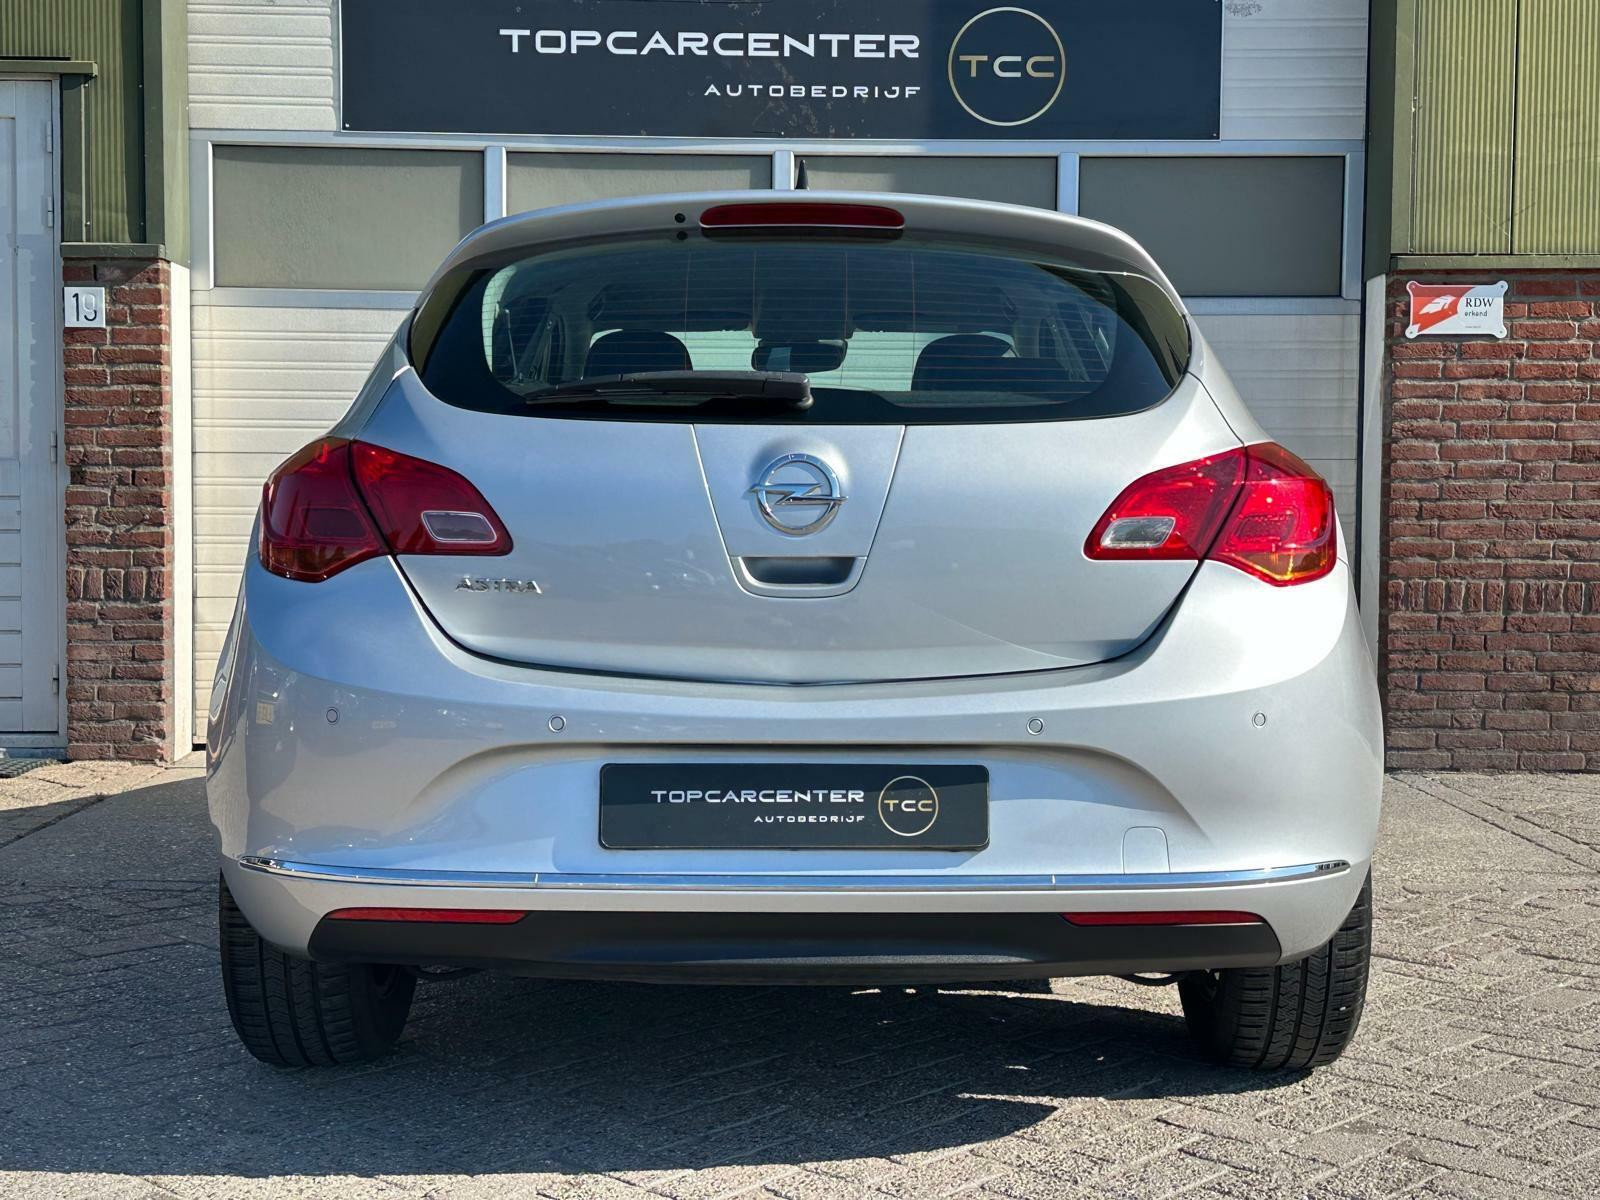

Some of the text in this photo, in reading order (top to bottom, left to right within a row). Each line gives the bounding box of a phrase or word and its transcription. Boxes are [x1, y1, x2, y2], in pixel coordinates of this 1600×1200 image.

[499, 28, 921, 58] TOPCARCENTER
[959, 54, 1055, 78] TCC
[704, 84, 921, 98] AUTOBEDRIJF
[72, 293, 97, 322] 19
[1465, 297, 1494, 308] RDW
[455, 576, 542, 594] ASTRA
[651, 789, 865, 803] TOPCARCENTER
[883, 799, 934, 812] TCC
[753, 815, 865, 823] AUTOBEDRIJF
